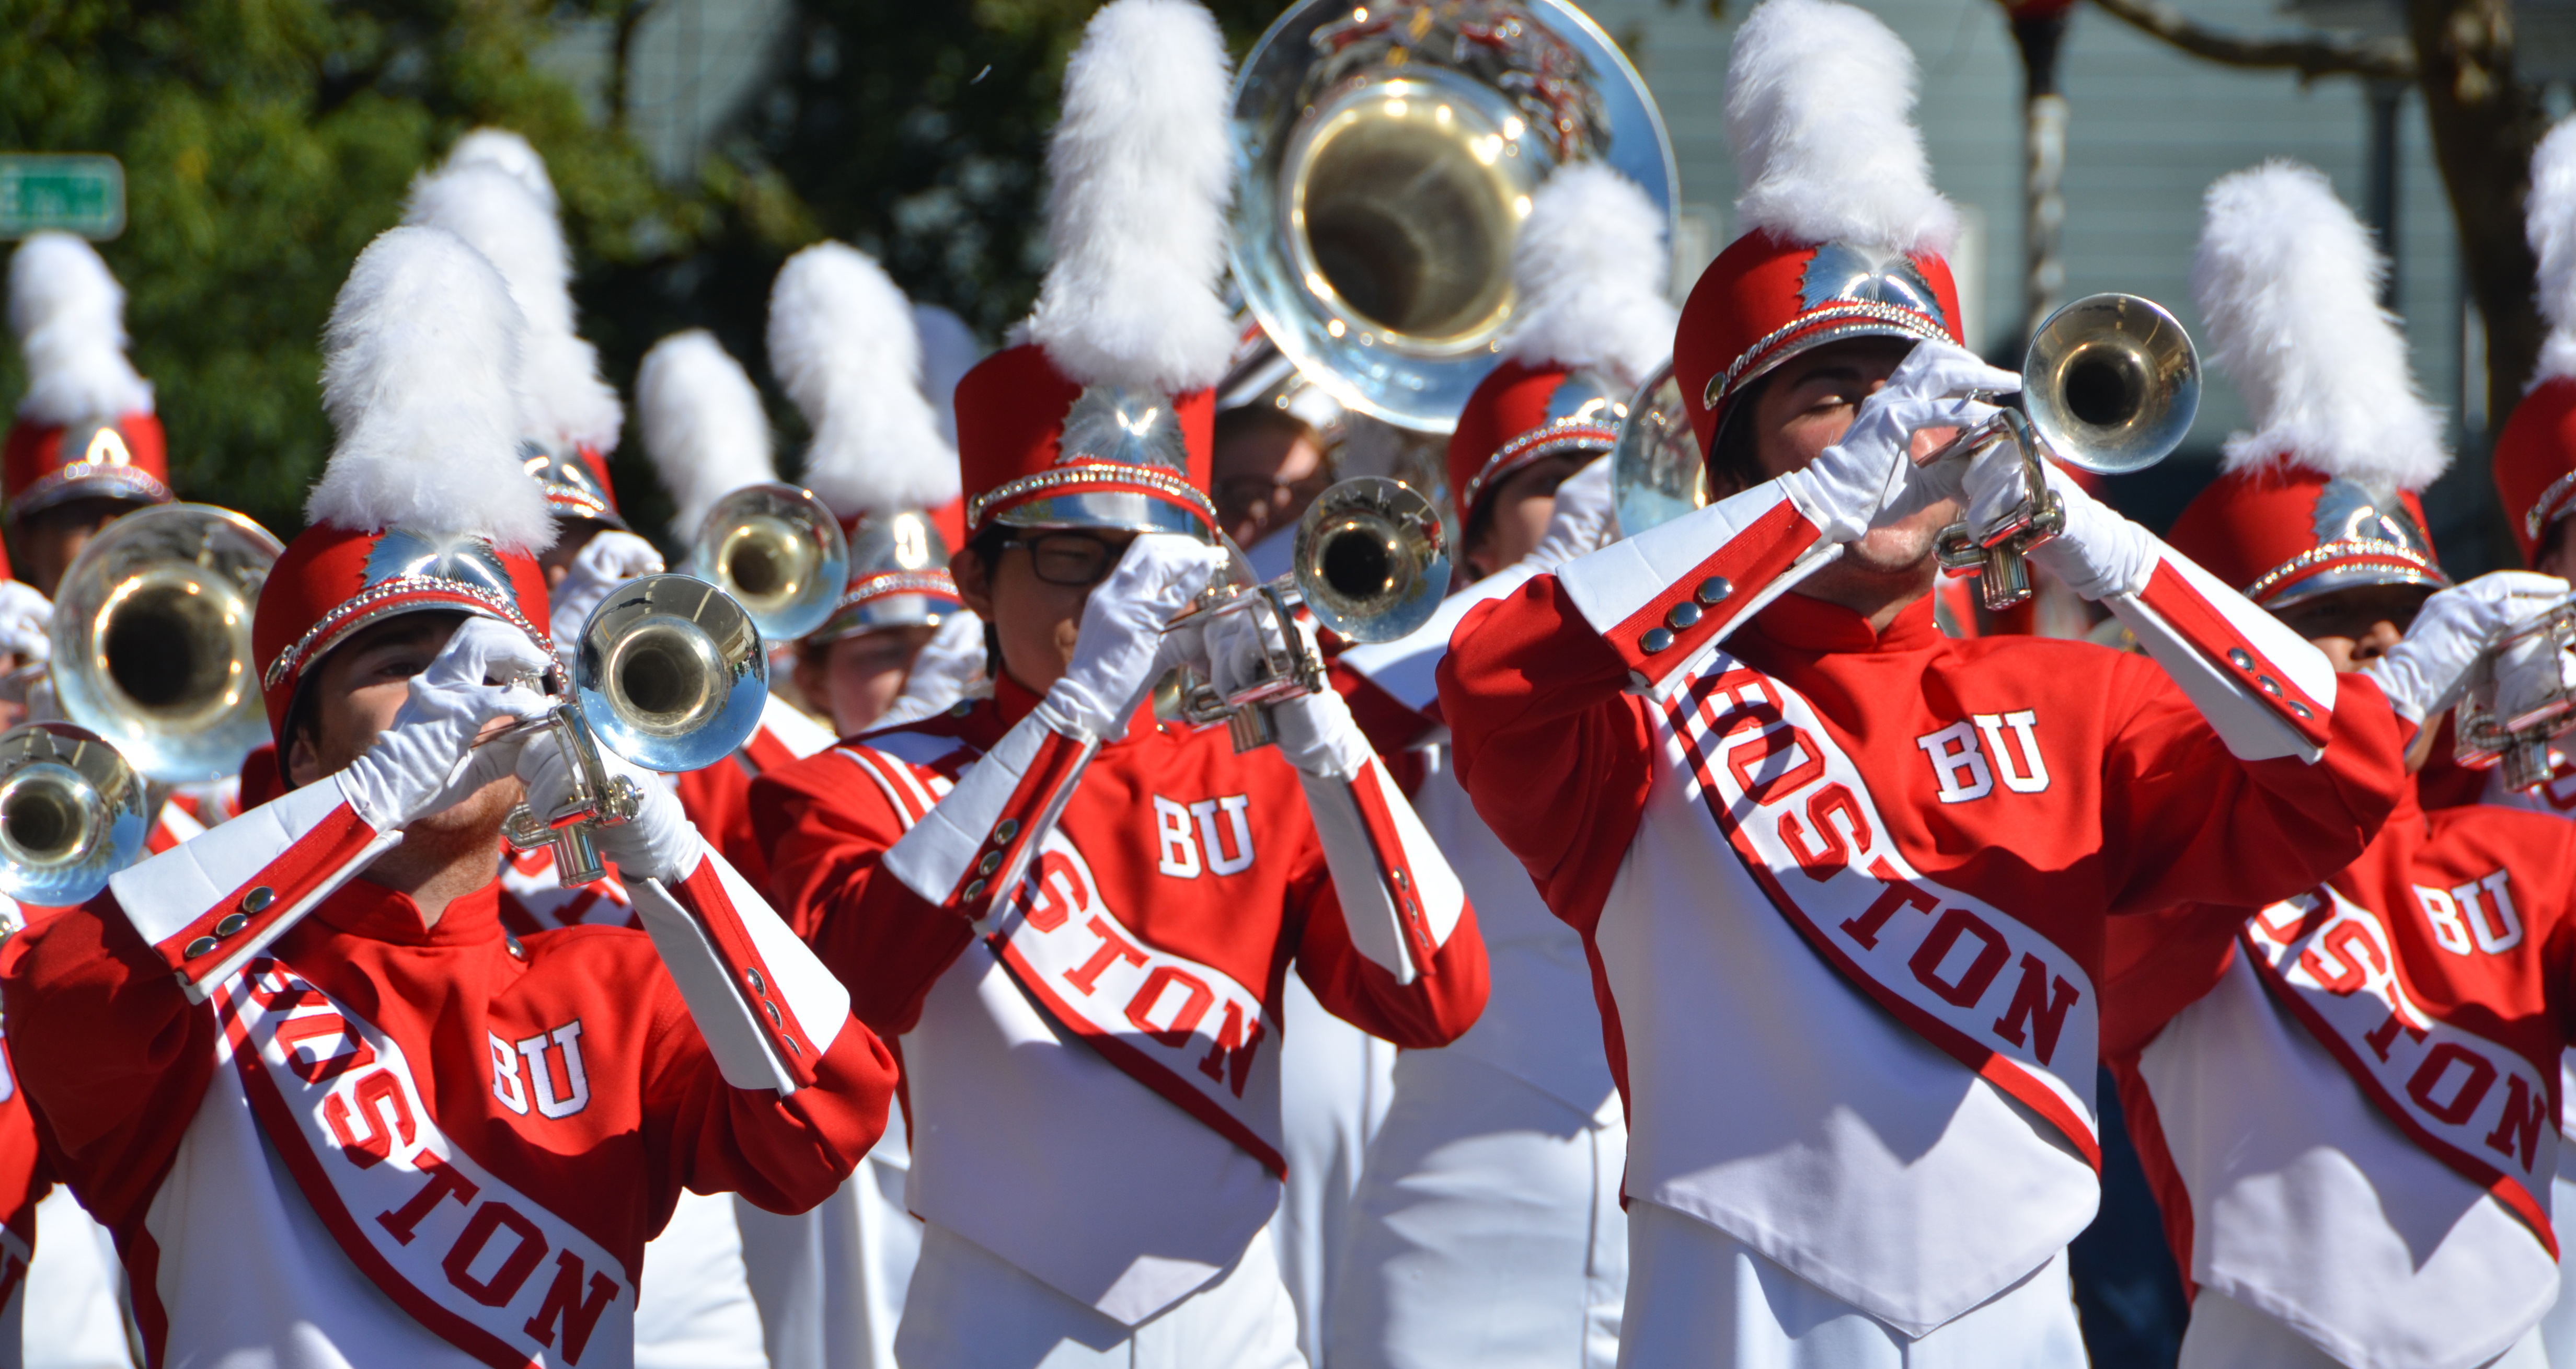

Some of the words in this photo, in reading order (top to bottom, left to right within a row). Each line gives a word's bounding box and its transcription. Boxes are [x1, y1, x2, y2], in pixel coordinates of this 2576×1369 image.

[1916, 710, 2050, 803] BU
[1153, 795, 1255, 879] BU
[1684, 666, 2079, 1066] BOSTON
[2412, 869, 2523, 955] BU
[488, 1017, 590, 1120] BU
[2255, 885, 2546, 1174] OSTON
[238, 957, 619, 1366] BOSTON
